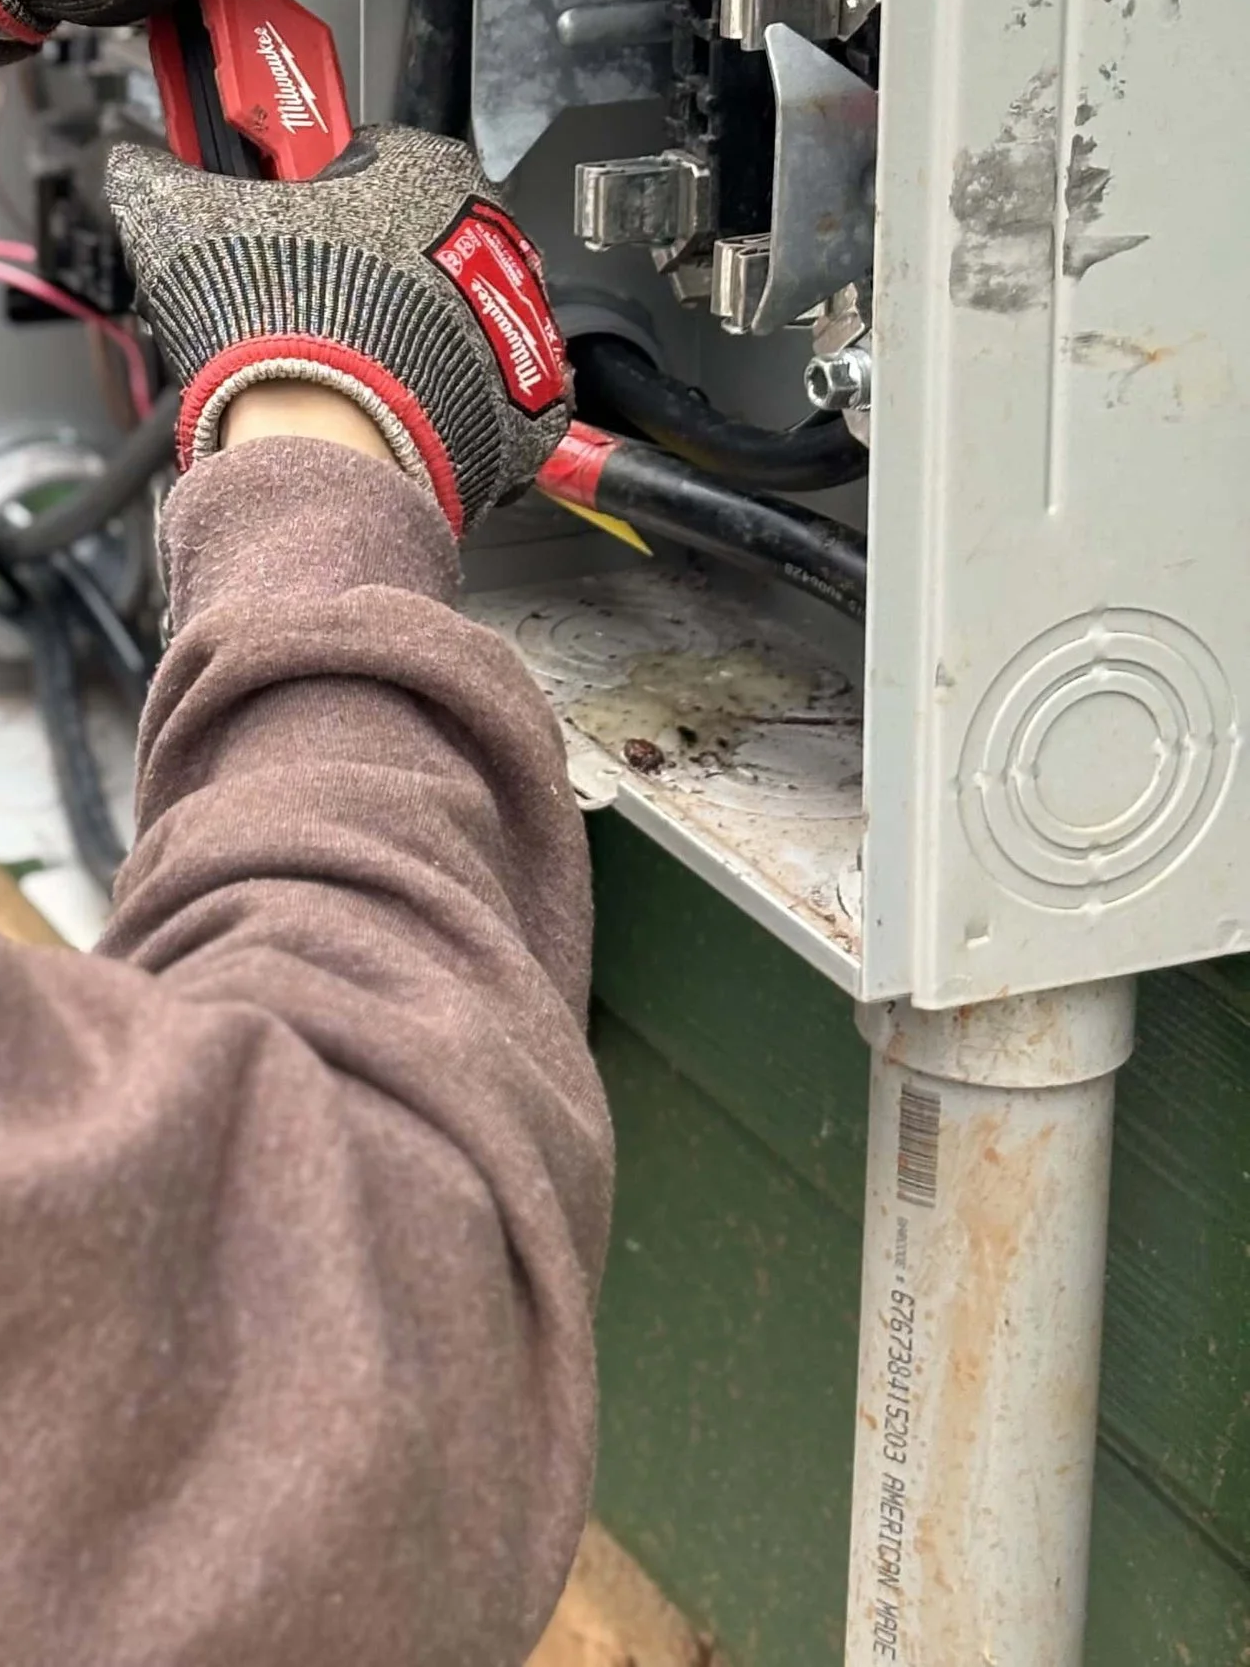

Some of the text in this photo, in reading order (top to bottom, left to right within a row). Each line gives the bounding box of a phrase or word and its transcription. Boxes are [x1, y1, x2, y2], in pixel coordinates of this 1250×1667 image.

[254, 26, 315, 134] Milwaukee
[471, 277, 541, 396] Milwaukee
[884, 1290, 915, 1465] 676738415203
[877, 1472, 906, 1591] AMERICAN
[873, 1598, 899, 1661] MADE
